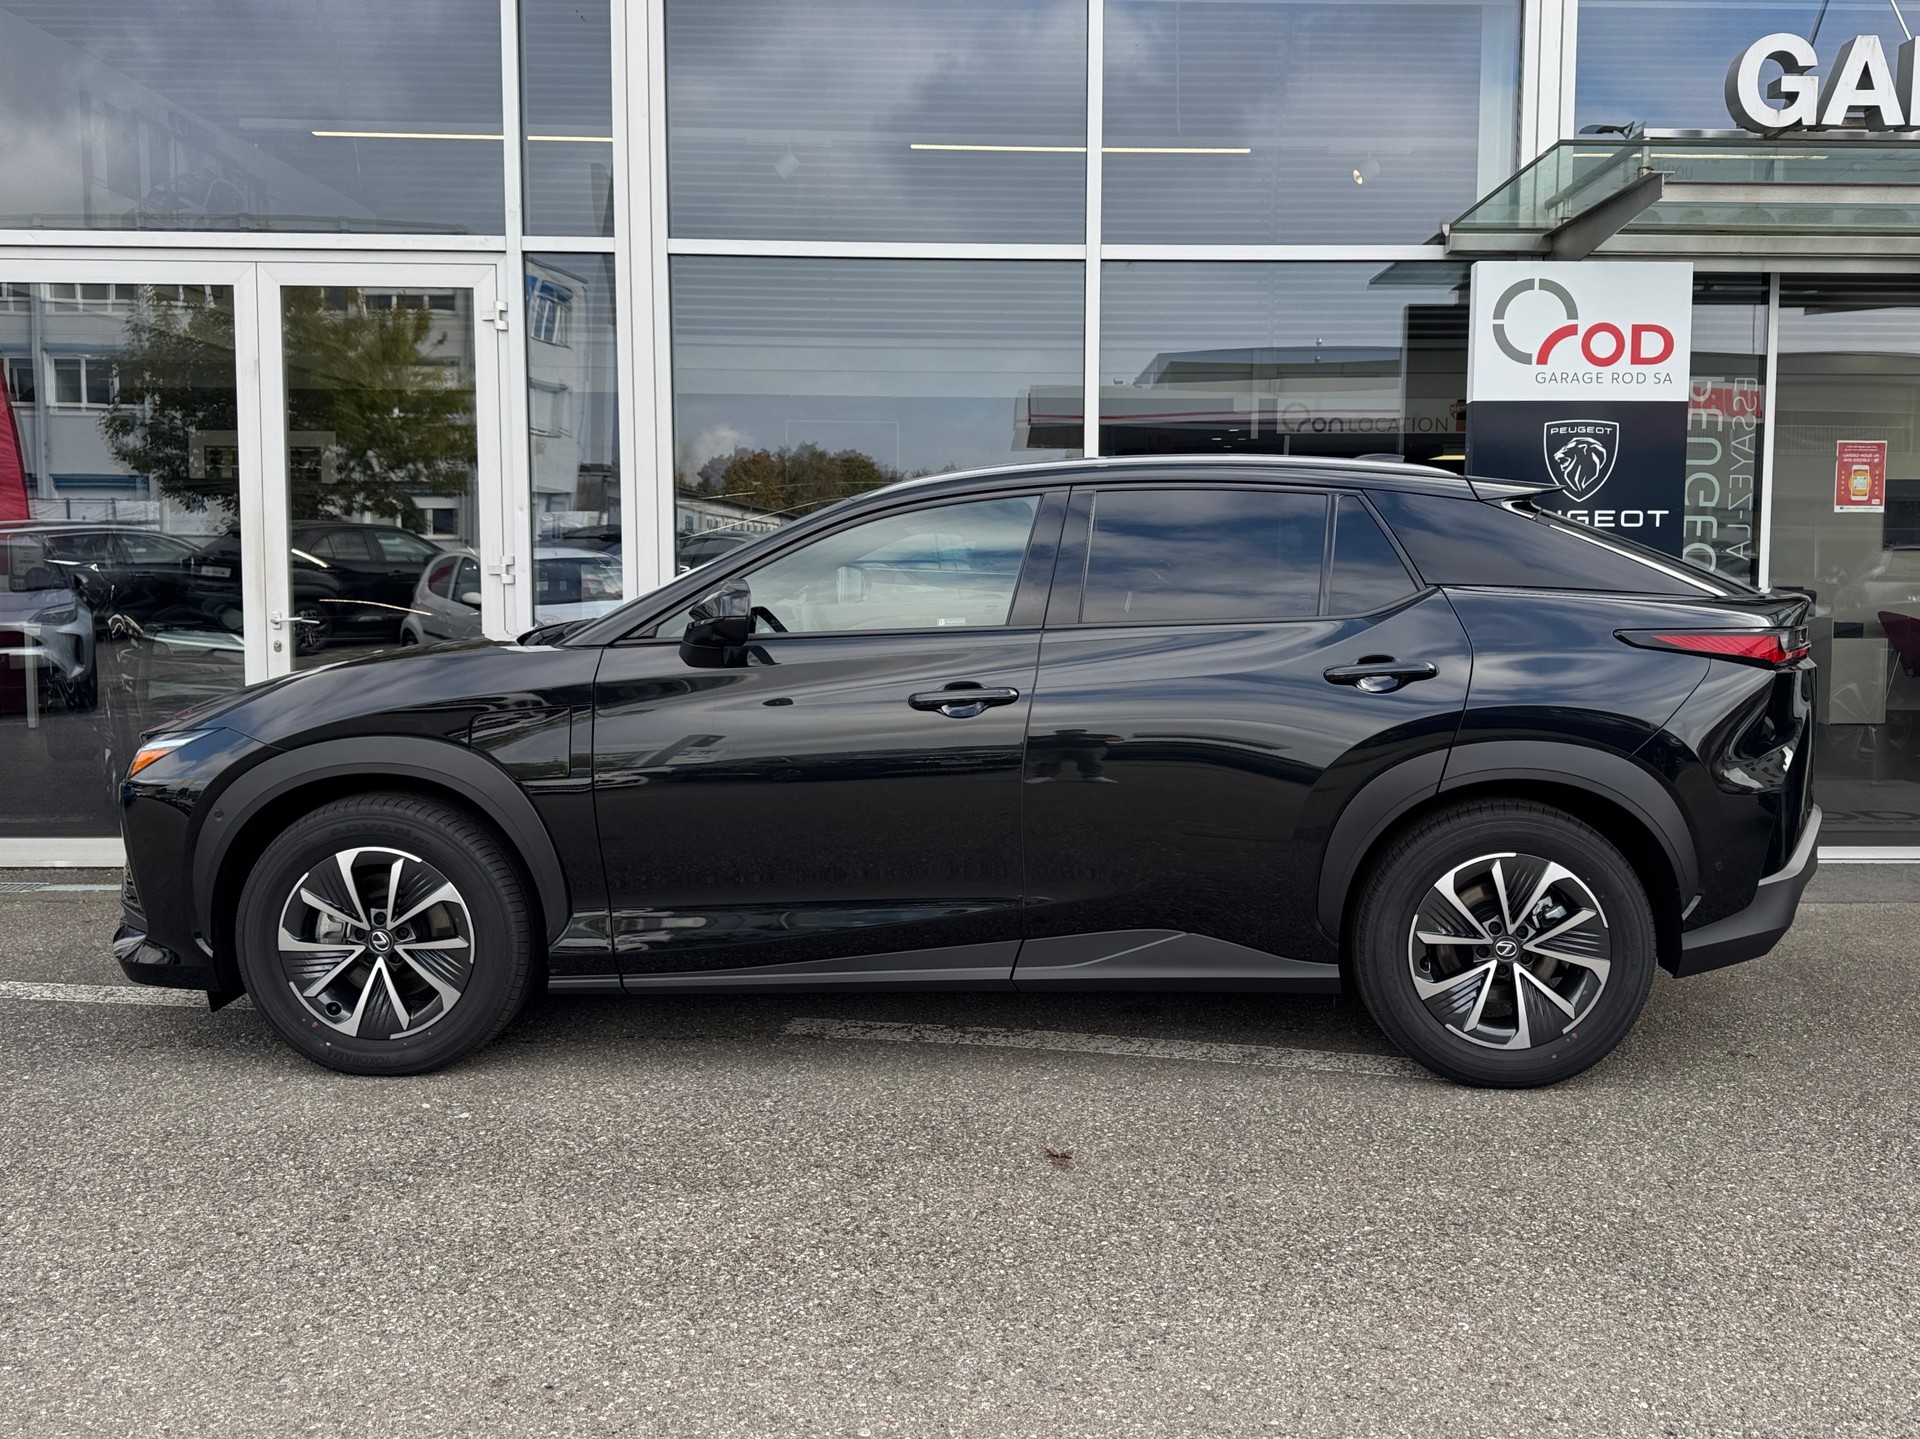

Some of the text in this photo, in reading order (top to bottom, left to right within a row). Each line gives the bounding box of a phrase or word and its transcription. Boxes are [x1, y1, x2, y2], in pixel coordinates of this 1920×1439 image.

[1726, 32, 1920, 132] GA
[1535, 371, 1673, 385] GARAGE ROD SA
[1348, 417, 1449, 433] LOCATION
[1550, 426, 1613, 435] PEUGEOT
[1558, 510, 1670, 528] GEOT
[326, 1046, 392, 1065] YOKOHAMA
